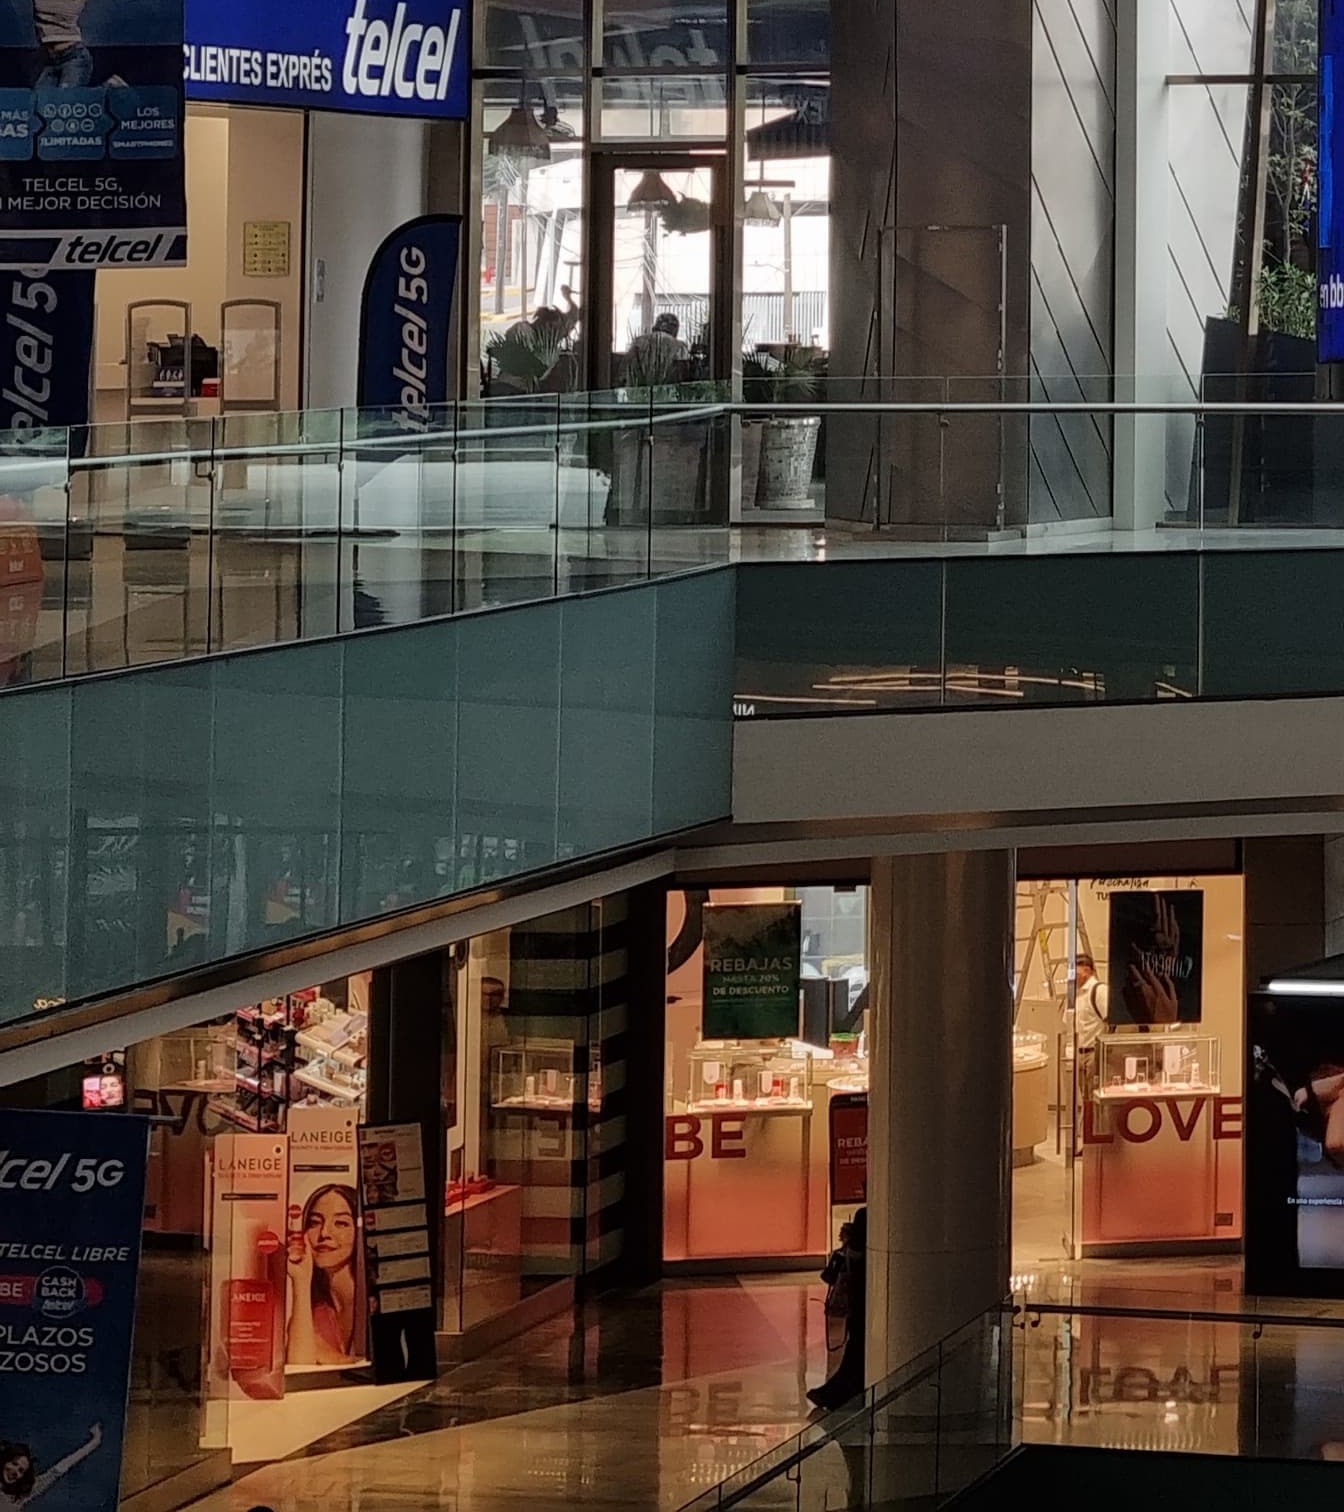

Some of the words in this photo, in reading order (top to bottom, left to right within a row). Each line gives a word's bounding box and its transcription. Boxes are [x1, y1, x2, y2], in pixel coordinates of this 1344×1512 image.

[266, 49, 333, 92] EXPRÉS
[136, 106, 160, 118] LOS
[121, 119, 175, 131] MEJORES
[22, 177, 90, 193] TELCEL
[95, 176, 123, 194] 5G,
[8, 195, 72, 211] MEJOR
[77, 191, 162, 211] DECISIÓN
[65, 234, 164, 264] telcel
[398, 245, 429, 305] 5G
[709, 956, 793, 973] REBAJAS
[1081, 1096, 1243, 1145] LOVE
[291, 1130, 353, 1143] LANEIGE
[666, 1113, 746, 1160] BE
[218, 1157, 281, 1171] LANEIGE
[71, 1157, 125, 1193] 5G
[72, 1246, 130, 1263] LIBRE
